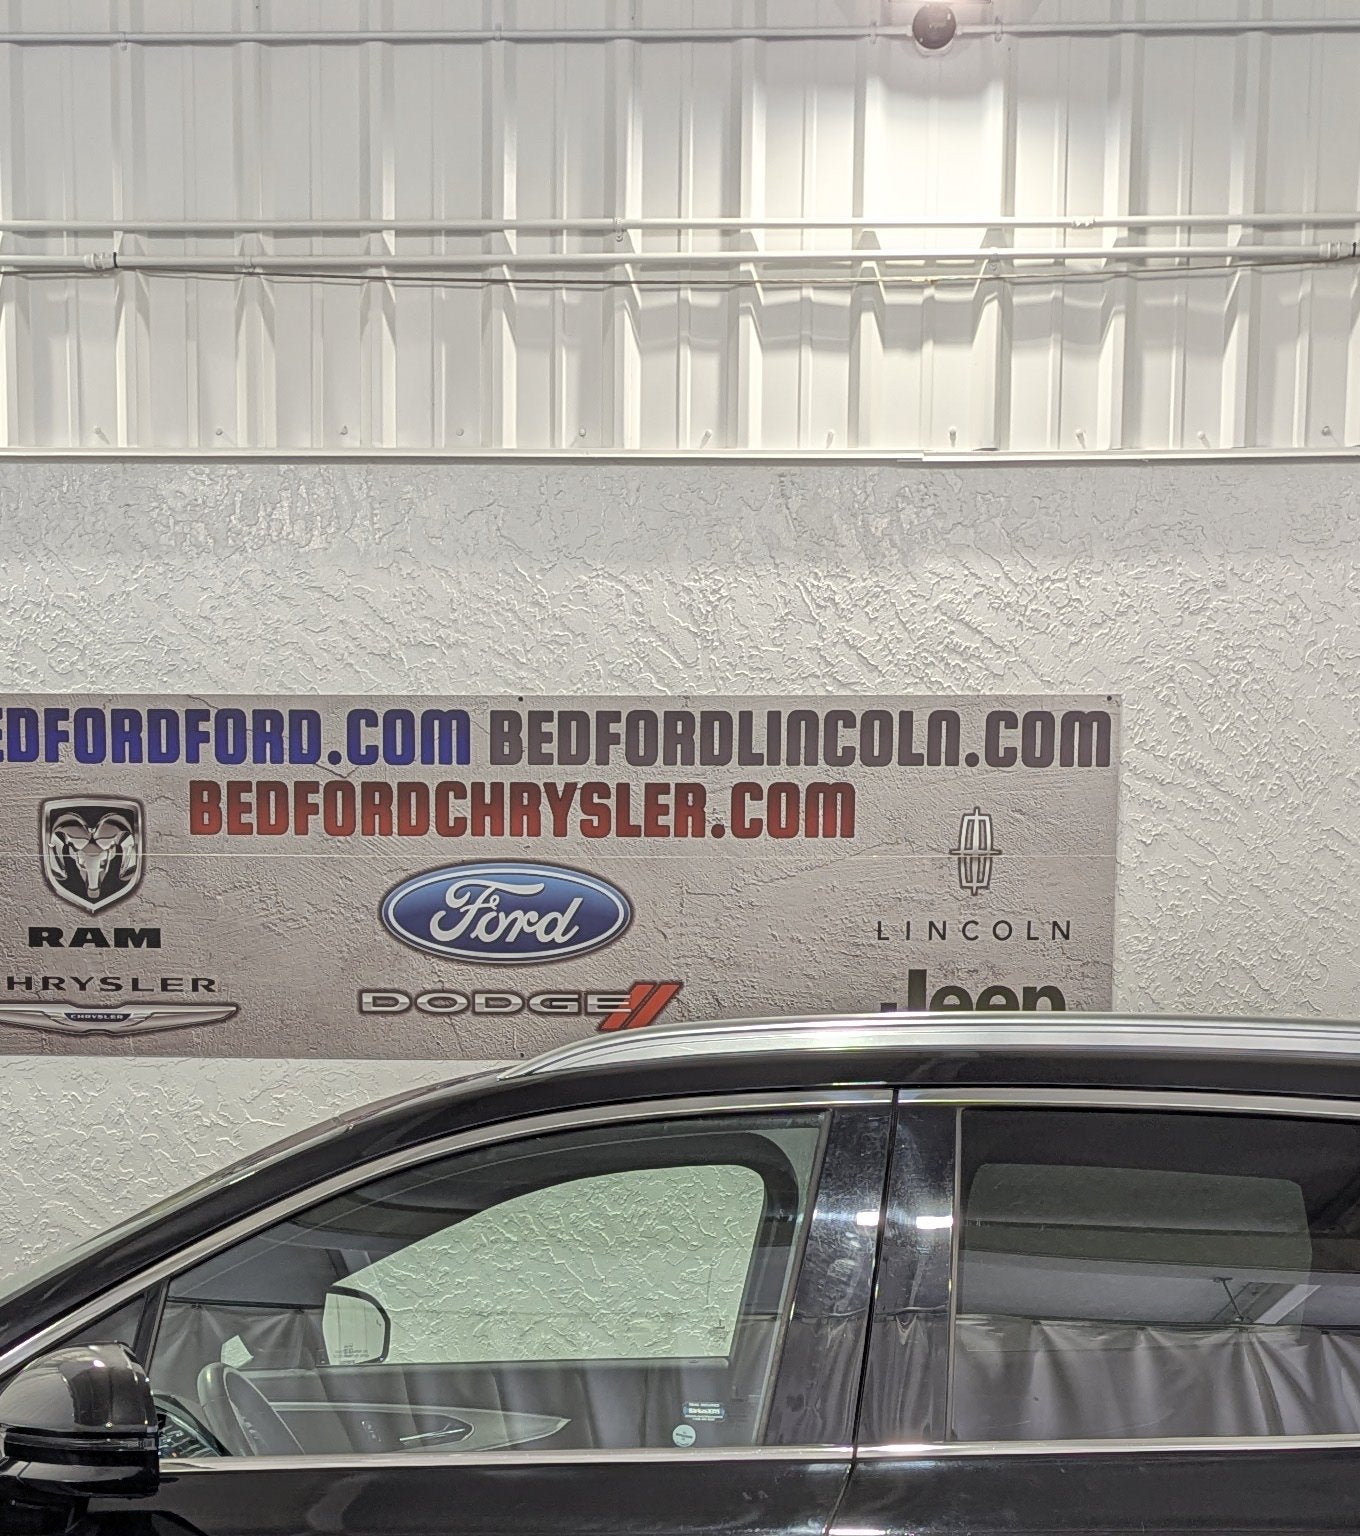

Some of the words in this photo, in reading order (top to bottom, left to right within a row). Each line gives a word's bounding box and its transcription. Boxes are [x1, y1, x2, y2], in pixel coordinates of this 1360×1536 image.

[490, 709, 1111, 768] BEDFORDLINCOLN.COM
[189, 780, 856, 838] BEDFORDCHRYSLER.COM
[429, 878, 584, 944] Ford
[876, 919, 1072, 942] LINCOLN
[27, 927, 162, 949] RAM
[360, 991, 633, 1014] DODGE
